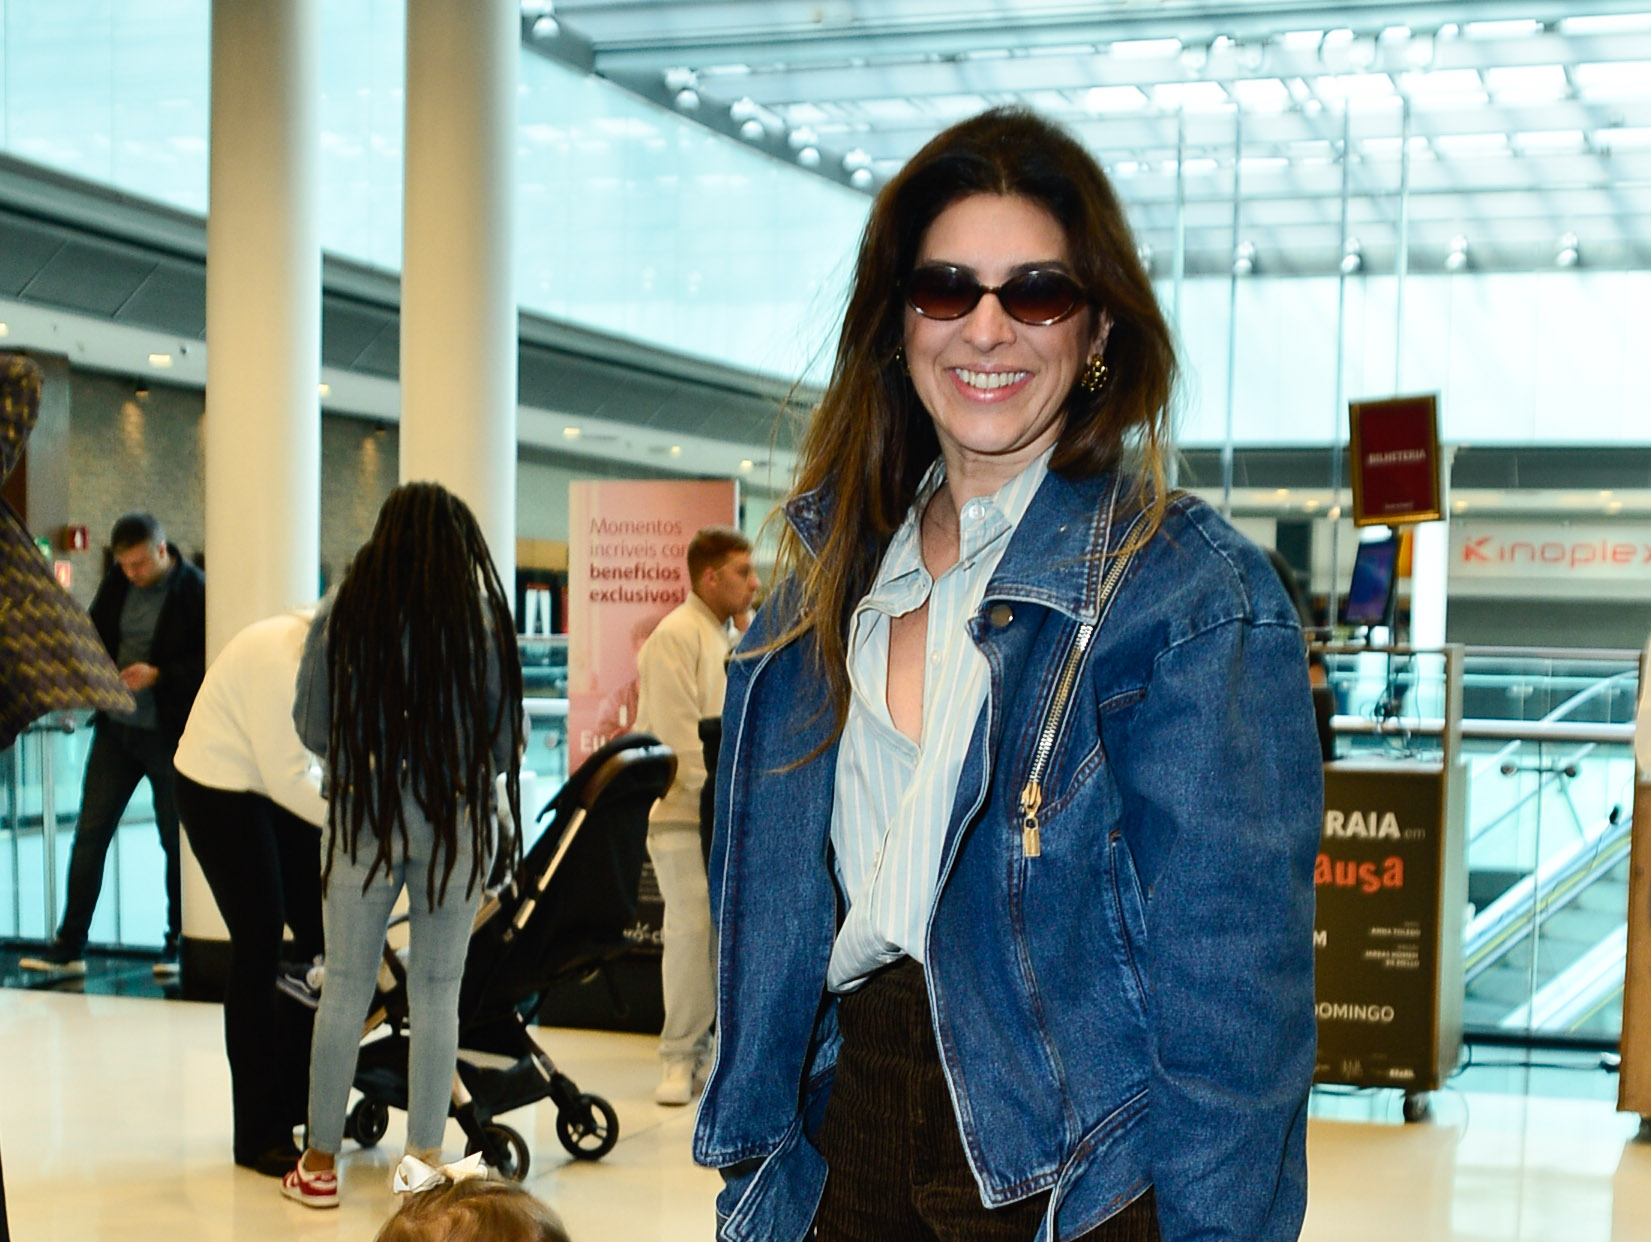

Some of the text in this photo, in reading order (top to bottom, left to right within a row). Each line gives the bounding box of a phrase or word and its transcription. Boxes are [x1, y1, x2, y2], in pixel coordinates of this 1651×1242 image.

[1368, 448, 1427, 465] BILHETERIA
[590, 518, 682, 535] Momentos
[590, 540, 657, 558] incríveis
[590, 562, 681, 580] benefícios
[590, 585, 686, 604] exclusivos!
[1326, 810, 1401, 838] RAIA
